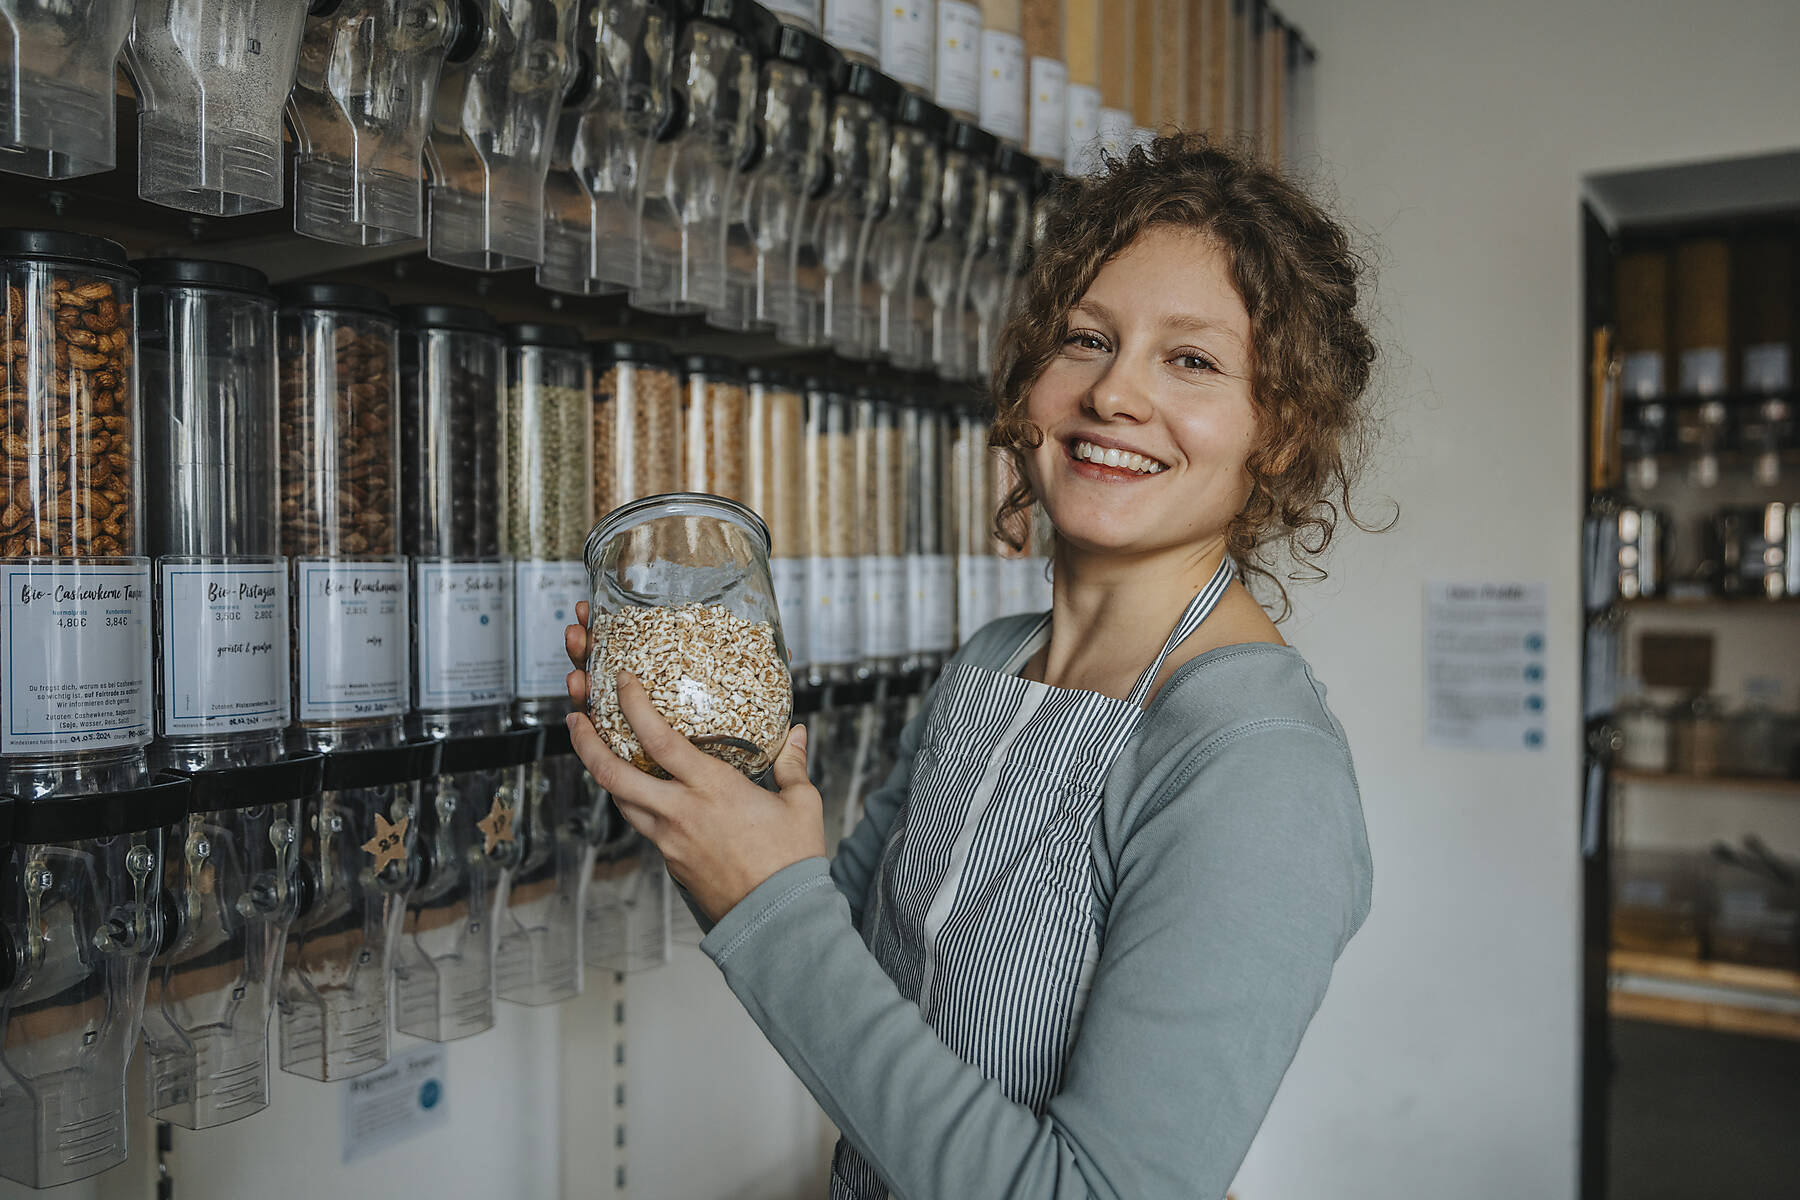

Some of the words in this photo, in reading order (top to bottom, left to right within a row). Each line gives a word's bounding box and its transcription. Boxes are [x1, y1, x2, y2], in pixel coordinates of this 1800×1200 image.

[57, 617, 87, 628] 4,80€
[105, 616, 128, 627] 3,84€
[29, 684, 38, 692] Du
[61, 682, 78, 691] dich,
[79, 681, 99, 690] warum
[84, 689, 94, 698] auf
[95, 688, 119, 698] Fairtrade
[56, 700, 68, 709] Wir
[69, 698, 104, 708] informieren
[104, 697, 116, 706] dich
[378, 832, 400, 851] 23
